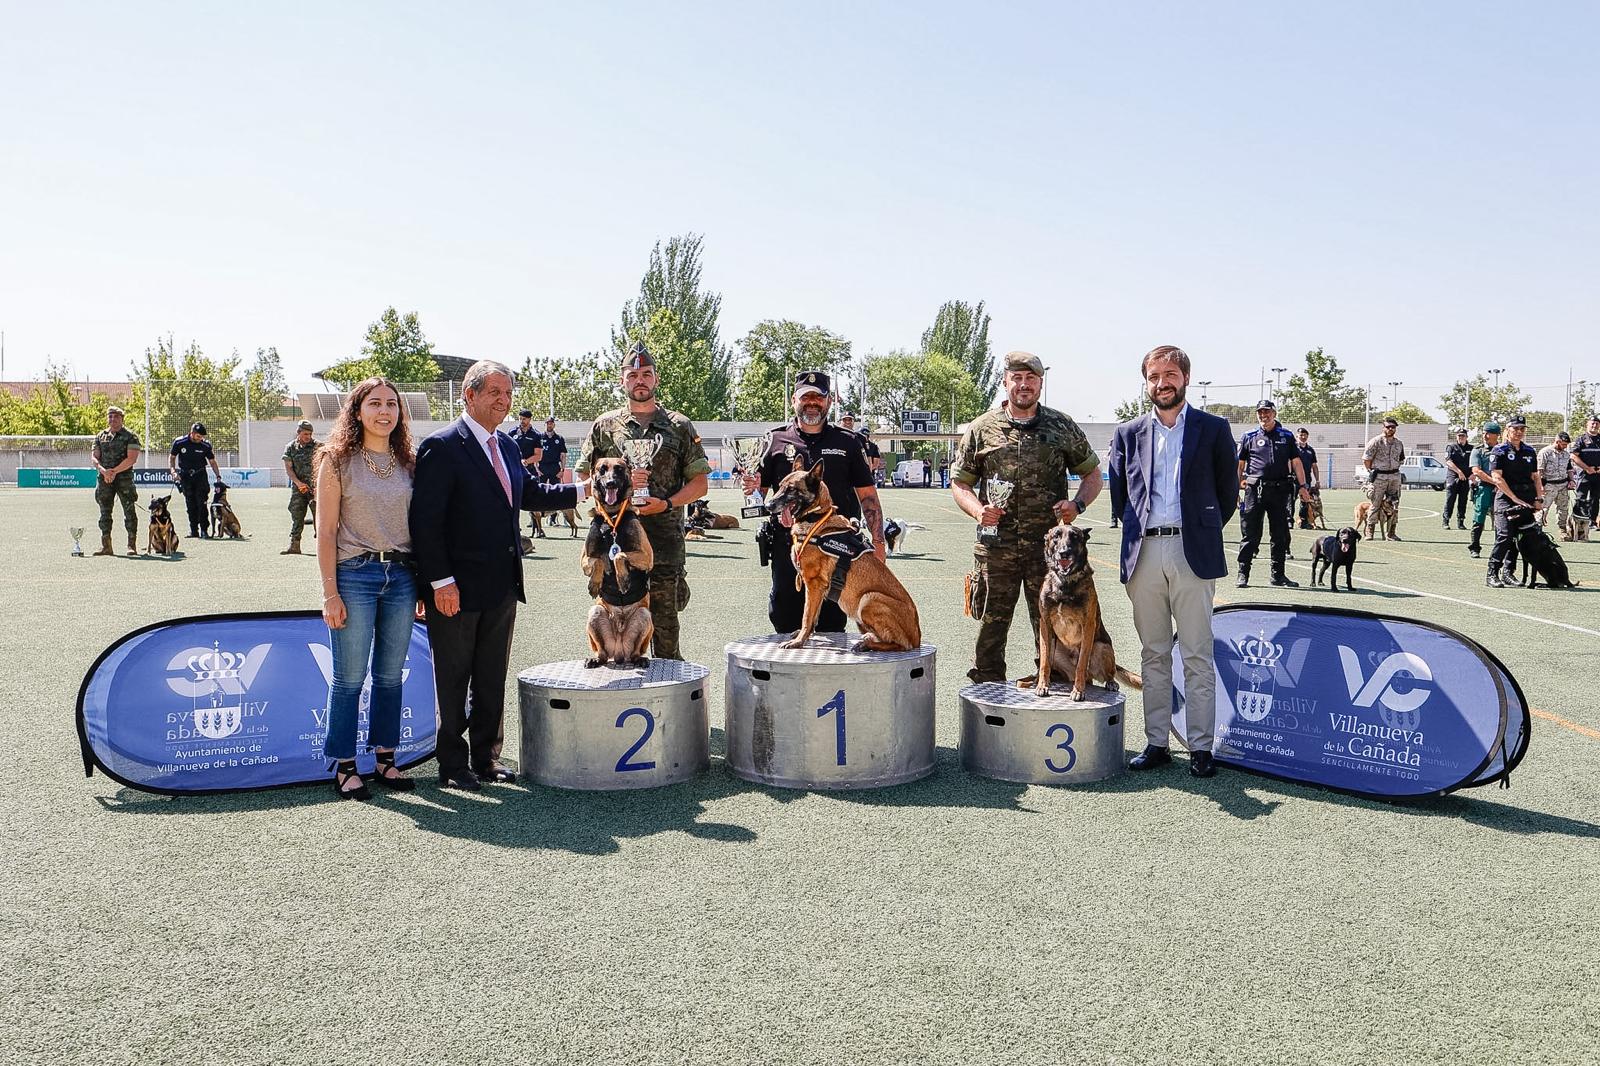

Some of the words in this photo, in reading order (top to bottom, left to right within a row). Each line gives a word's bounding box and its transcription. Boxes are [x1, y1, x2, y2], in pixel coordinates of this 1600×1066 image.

[142, 472, 172, 482] Galicia
[1337, 645, 1433, 712] VC
[614, 707, 656, 773] 2
[816, 689, 846, 766] 1
[1219, 724, 1271, 740] Ayuntamiento
[1272, 733, 1284, 742] de
[1328, 712, 1424, 746] Villanueva
[174, 746, 246, 759] Ayuntamiento
[248, 744, 262, 752] de
[1044, 723, 1077, 774] 3
[1214, 735, 1242, 747] lanueva
[1244, 740, 1254, 750] de
[1256, 742, 1263, 751] la
[1265, 744, 1295, 758] Cañada
[1323, 741, 1336, 751] de
[1336, 742, 1344, 753] la
[1348, 737, 1420, 767] Cañada
[157, 761, 210, 773] Villanueva
[213, 760, 226, 768] de
[229, 758, 238, 767] la
[241, 754, 279, 766] Cañada
[1321, 756, 1392, 776] SENCILLAMENTE
[1396, 769, 1420, 781] TODO
